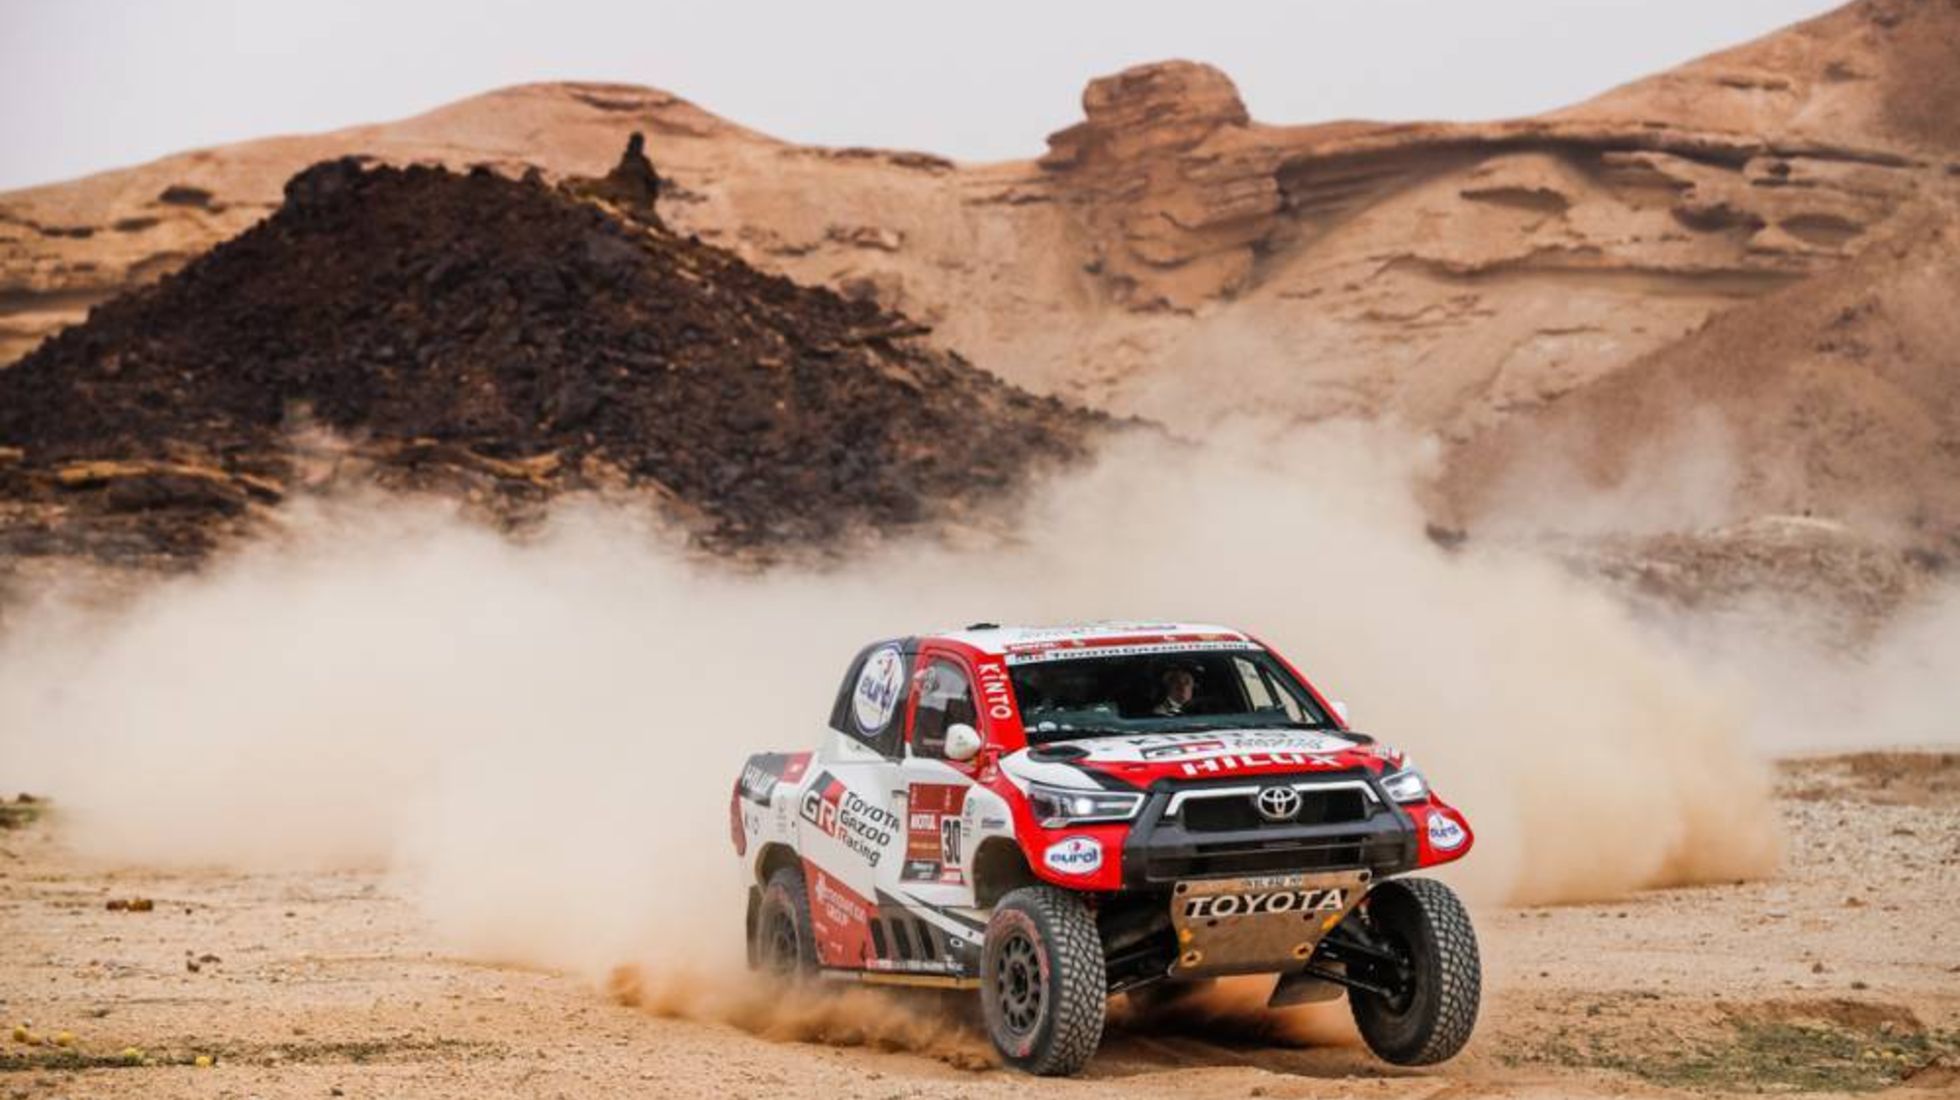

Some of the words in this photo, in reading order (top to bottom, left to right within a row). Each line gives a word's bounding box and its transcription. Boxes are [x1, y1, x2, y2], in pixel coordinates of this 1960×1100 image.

[1051, 648, 1116, 658] TOYOTA
[1181, 753, 1341, 775] HILUX
[801, 785, 839, 838] GR
[840, 809, 891, 846] GAZOO
[845, 791, 899, 833] TOYOTA
[838, 826, 881, 867] Racing
[943, 819, 961, 864] 30
[1050, 848, 1098, 863] eurol
[1188, 888, 1344, 918] TOYOTA
